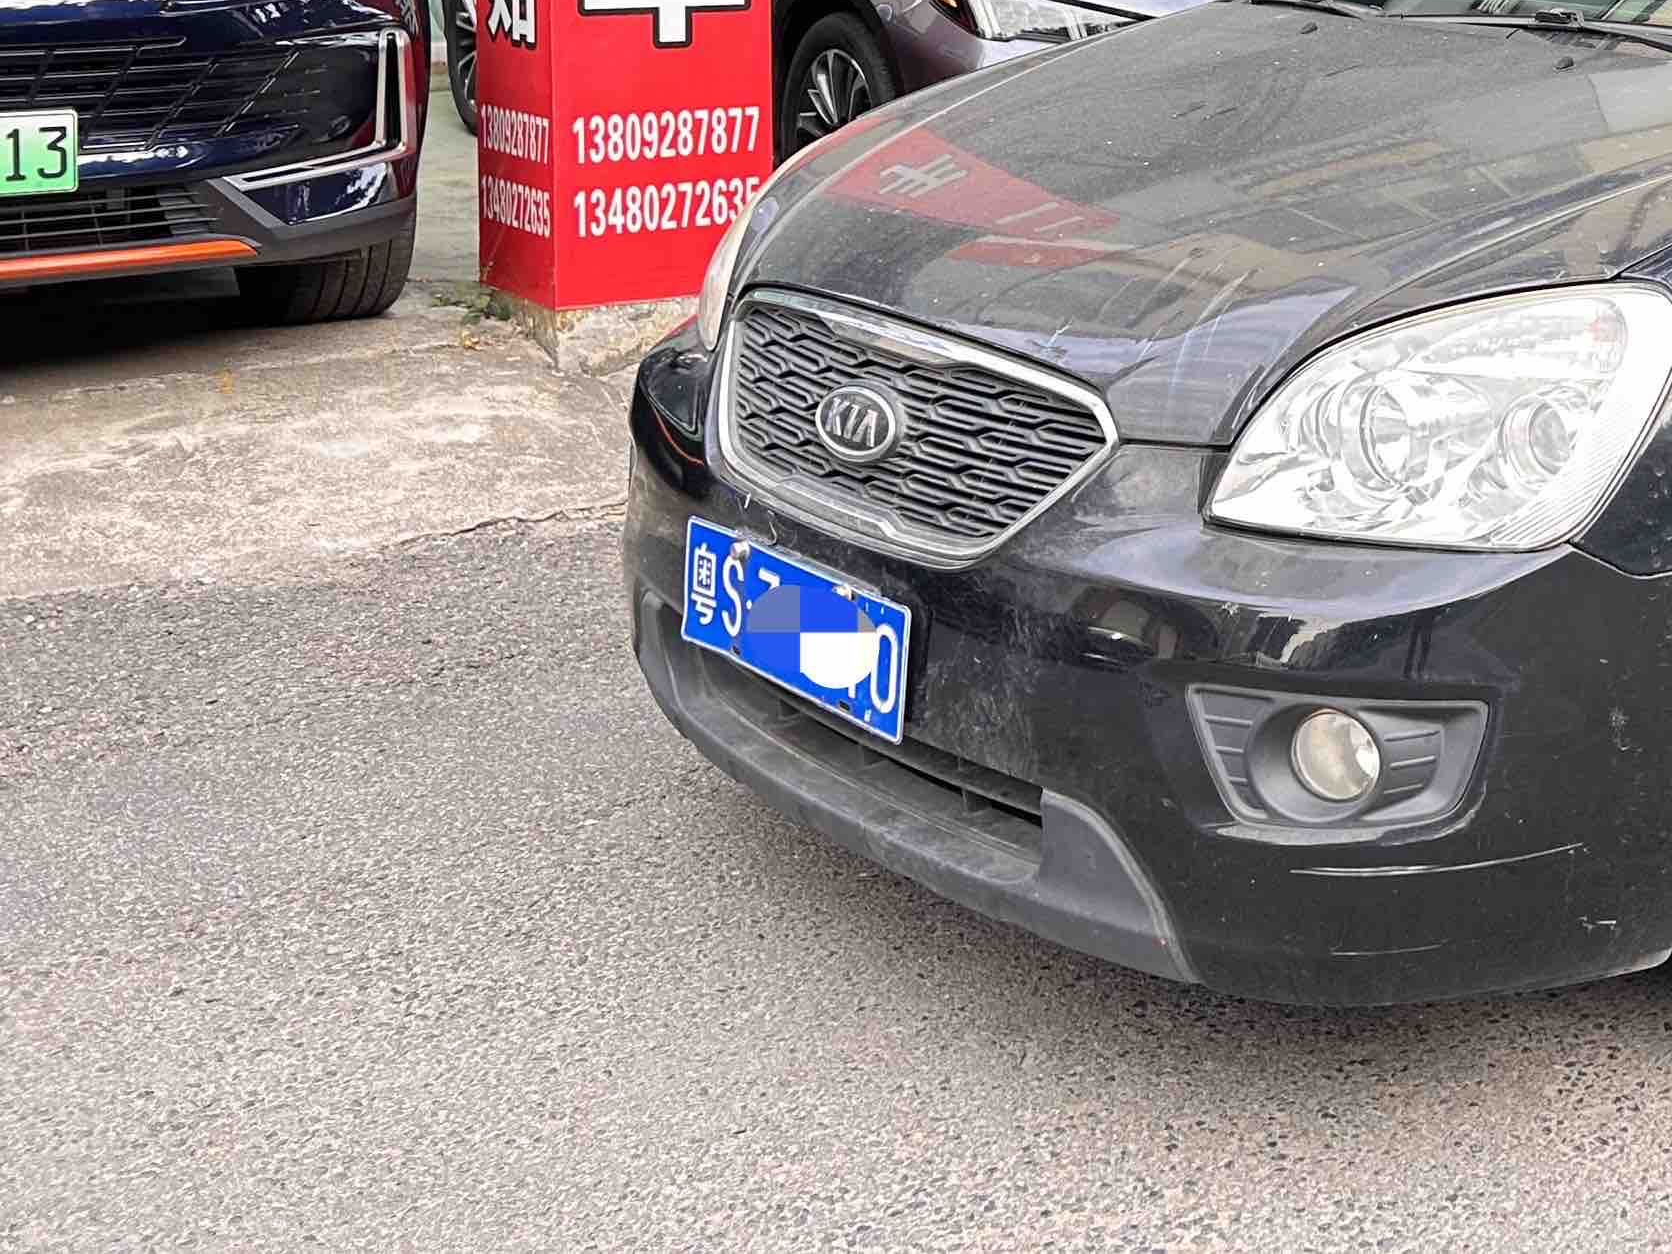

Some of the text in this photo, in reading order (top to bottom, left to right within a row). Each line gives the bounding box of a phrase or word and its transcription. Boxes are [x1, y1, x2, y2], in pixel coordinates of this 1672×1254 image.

[6, 126, 67, 182] 13
[480, 103, 550, 165] 13809287877
[572, 106, 760, 164] 13809287877
[480, 174, 551, 239] 13480272635
[825, 397, 878, 448] KIA
